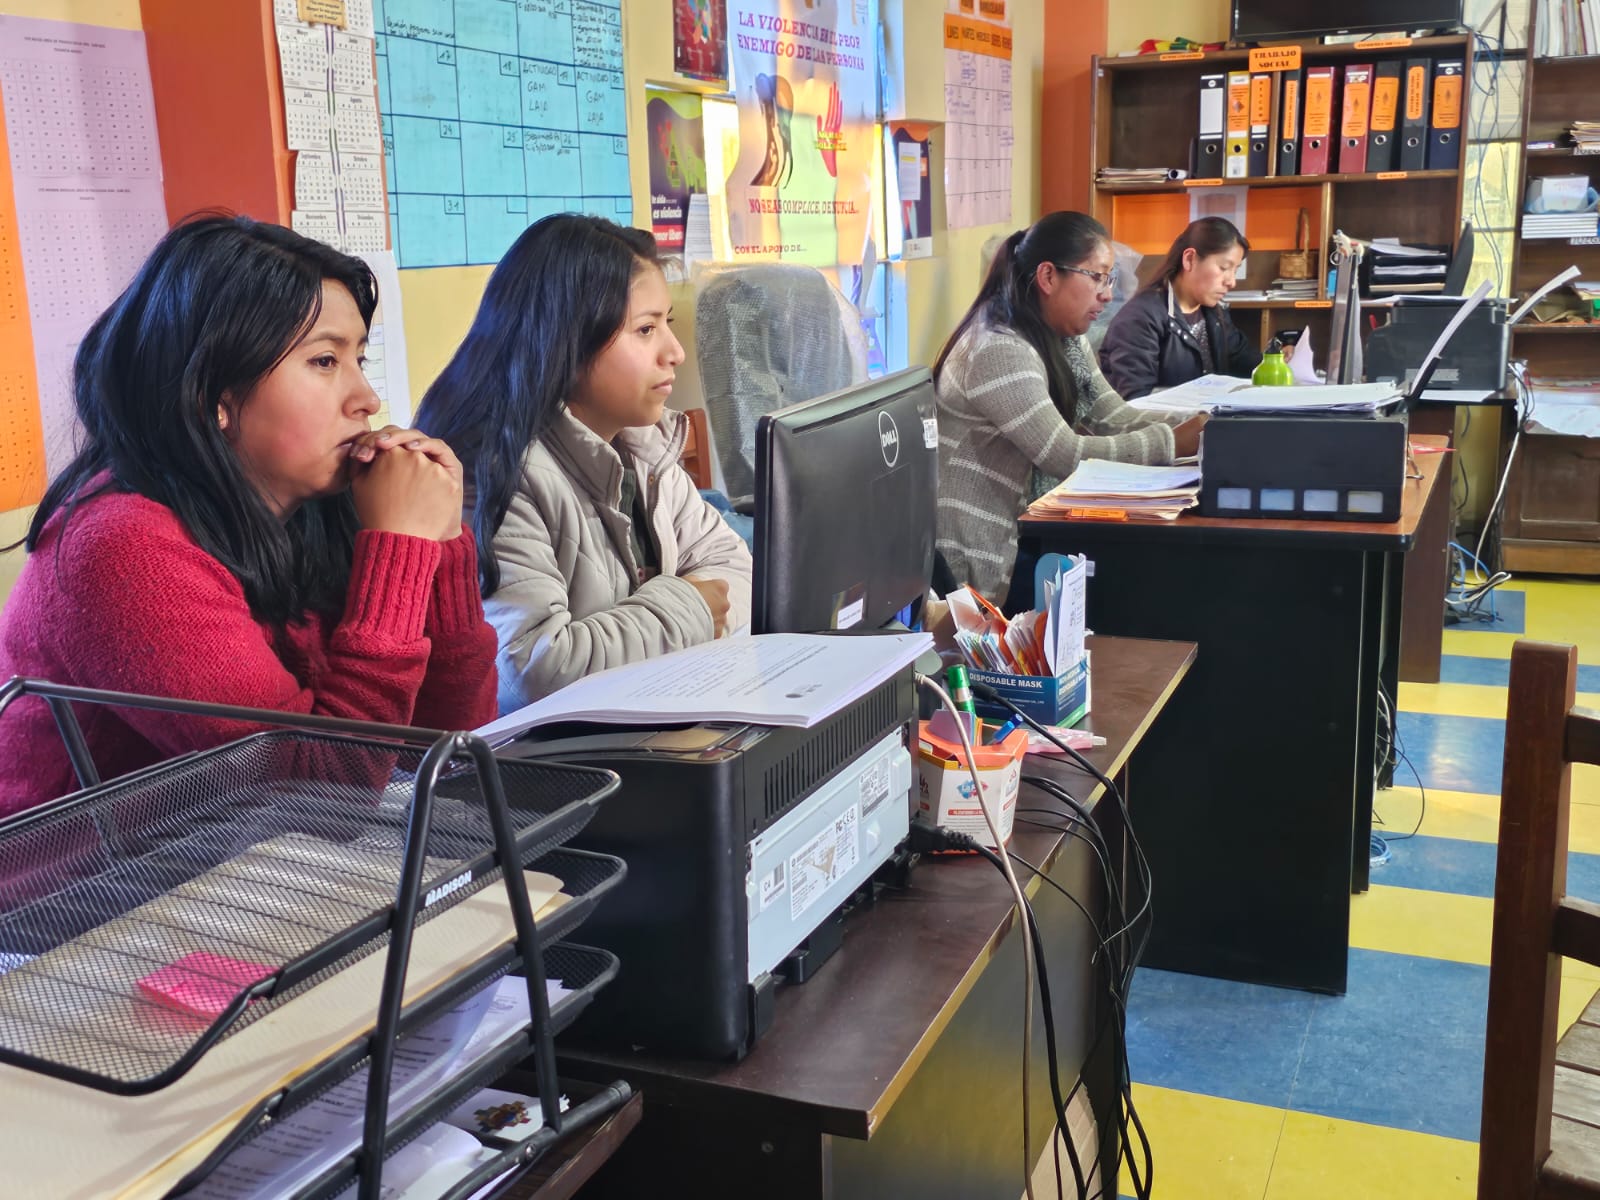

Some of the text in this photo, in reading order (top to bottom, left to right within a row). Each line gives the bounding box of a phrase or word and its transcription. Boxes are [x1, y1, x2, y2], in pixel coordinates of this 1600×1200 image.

[739, 11, 755, 28] LA
[758, 14, 818, 41] VIOLENCIA
[737, 33, 795, 58] ENEMIGO
[796, 44, 812, 61] DE
[439, 50, 451, 60] 17
[1253, 50, 1297, 59] TRABAJO
[503, 61, 512, 71] 18
[527, 81, 546, 93] GAM
[586, 90, 606, 103] GAM
[443, 124, 454, 136] 24
[506, 130, 517, 143] 25
[447, 199, 460, 212] 31
[748, 198, 761, 214] NO
[761, 199, 782, 214] SEAS
[734, 246, 752, 255] CON
[752, 246, 761, 254] EL
[762, 245, 790, 254] APOYO
[881, 429, 897, 447] DELL
[969, 672, 1043, 688] DISPOSABLE MASK
[425, 869, 472, 907] MADISON
